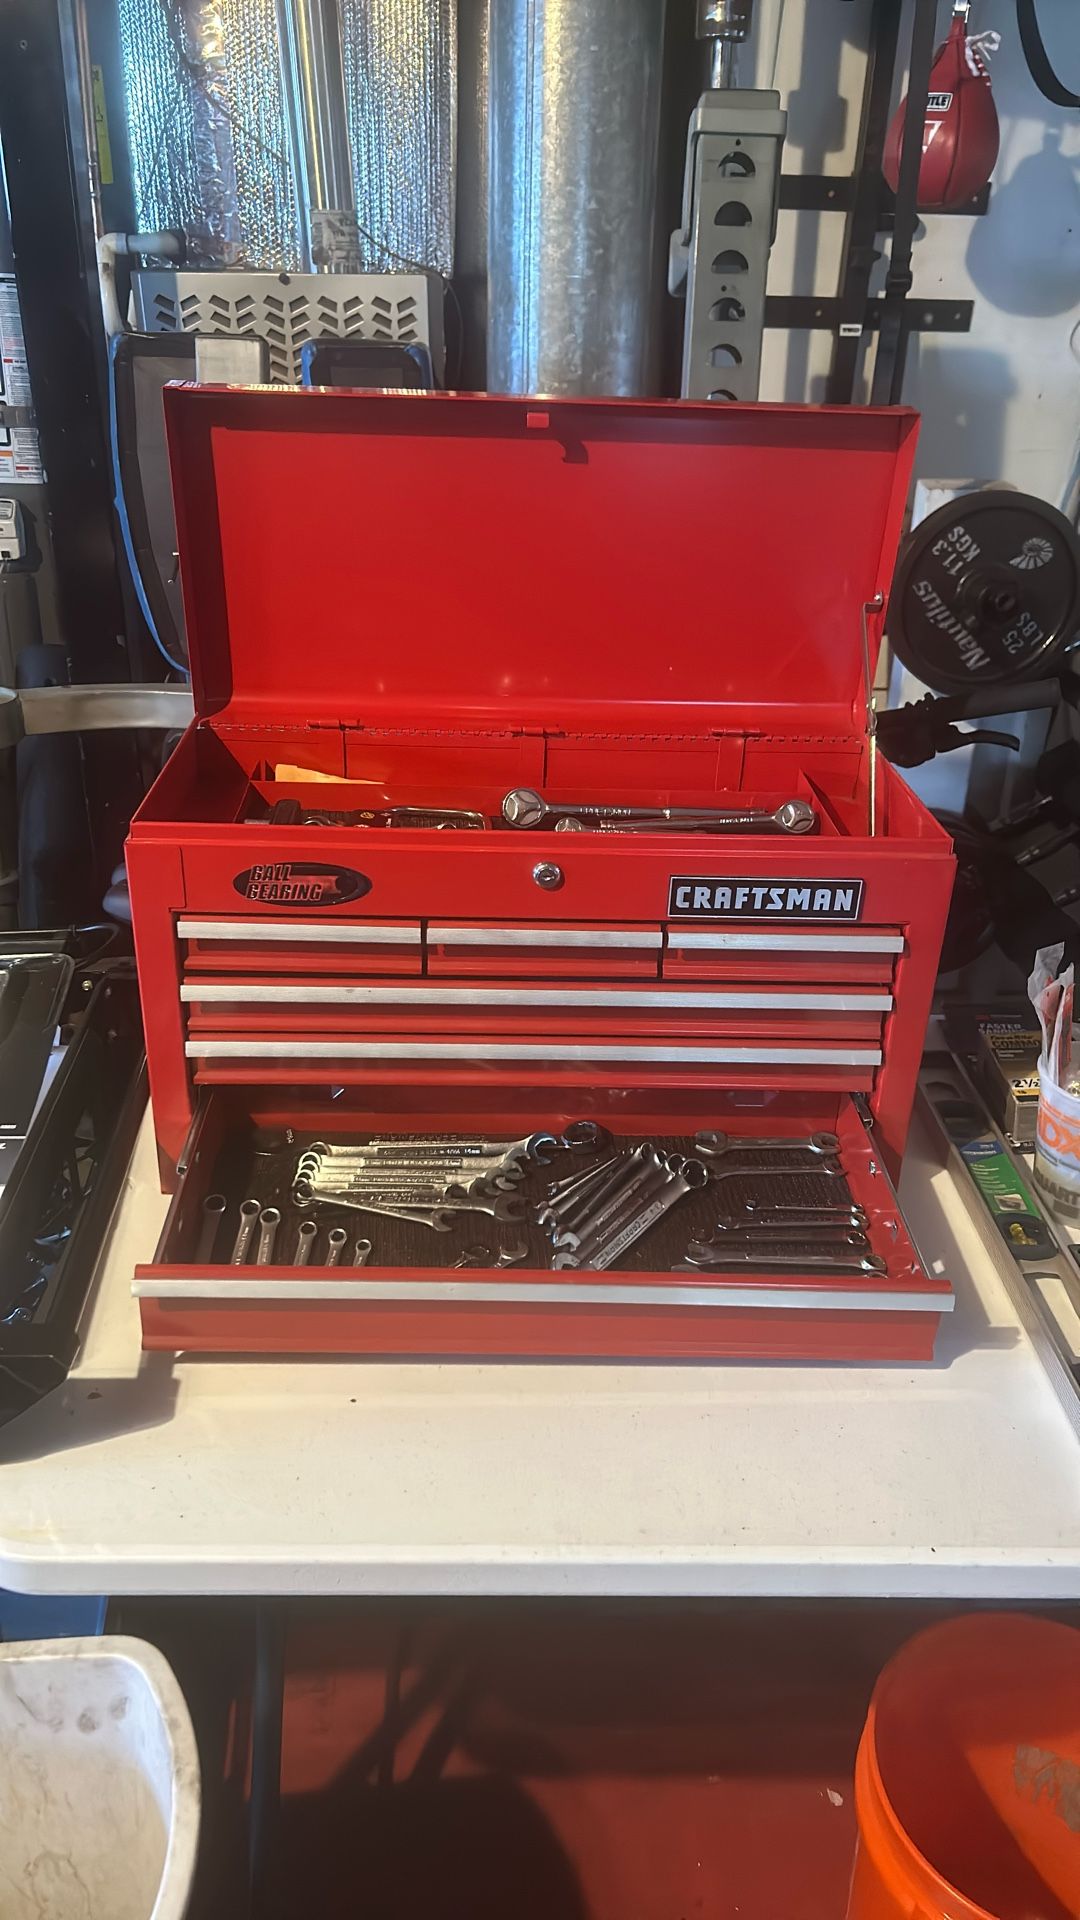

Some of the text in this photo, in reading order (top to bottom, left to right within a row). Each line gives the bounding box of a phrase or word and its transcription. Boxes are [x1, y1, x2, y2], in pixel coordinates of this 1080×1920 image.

[931, 539, 965, 576] 11.3
[948, 526, 981, 562] KGS
[912, 580, 991, 672] Nautilus
[1002, 631, 1025, 655] 25
[1016, 612, 1044, 647] LBS
[675, 886, 854, 911] CRAFTSMAN
